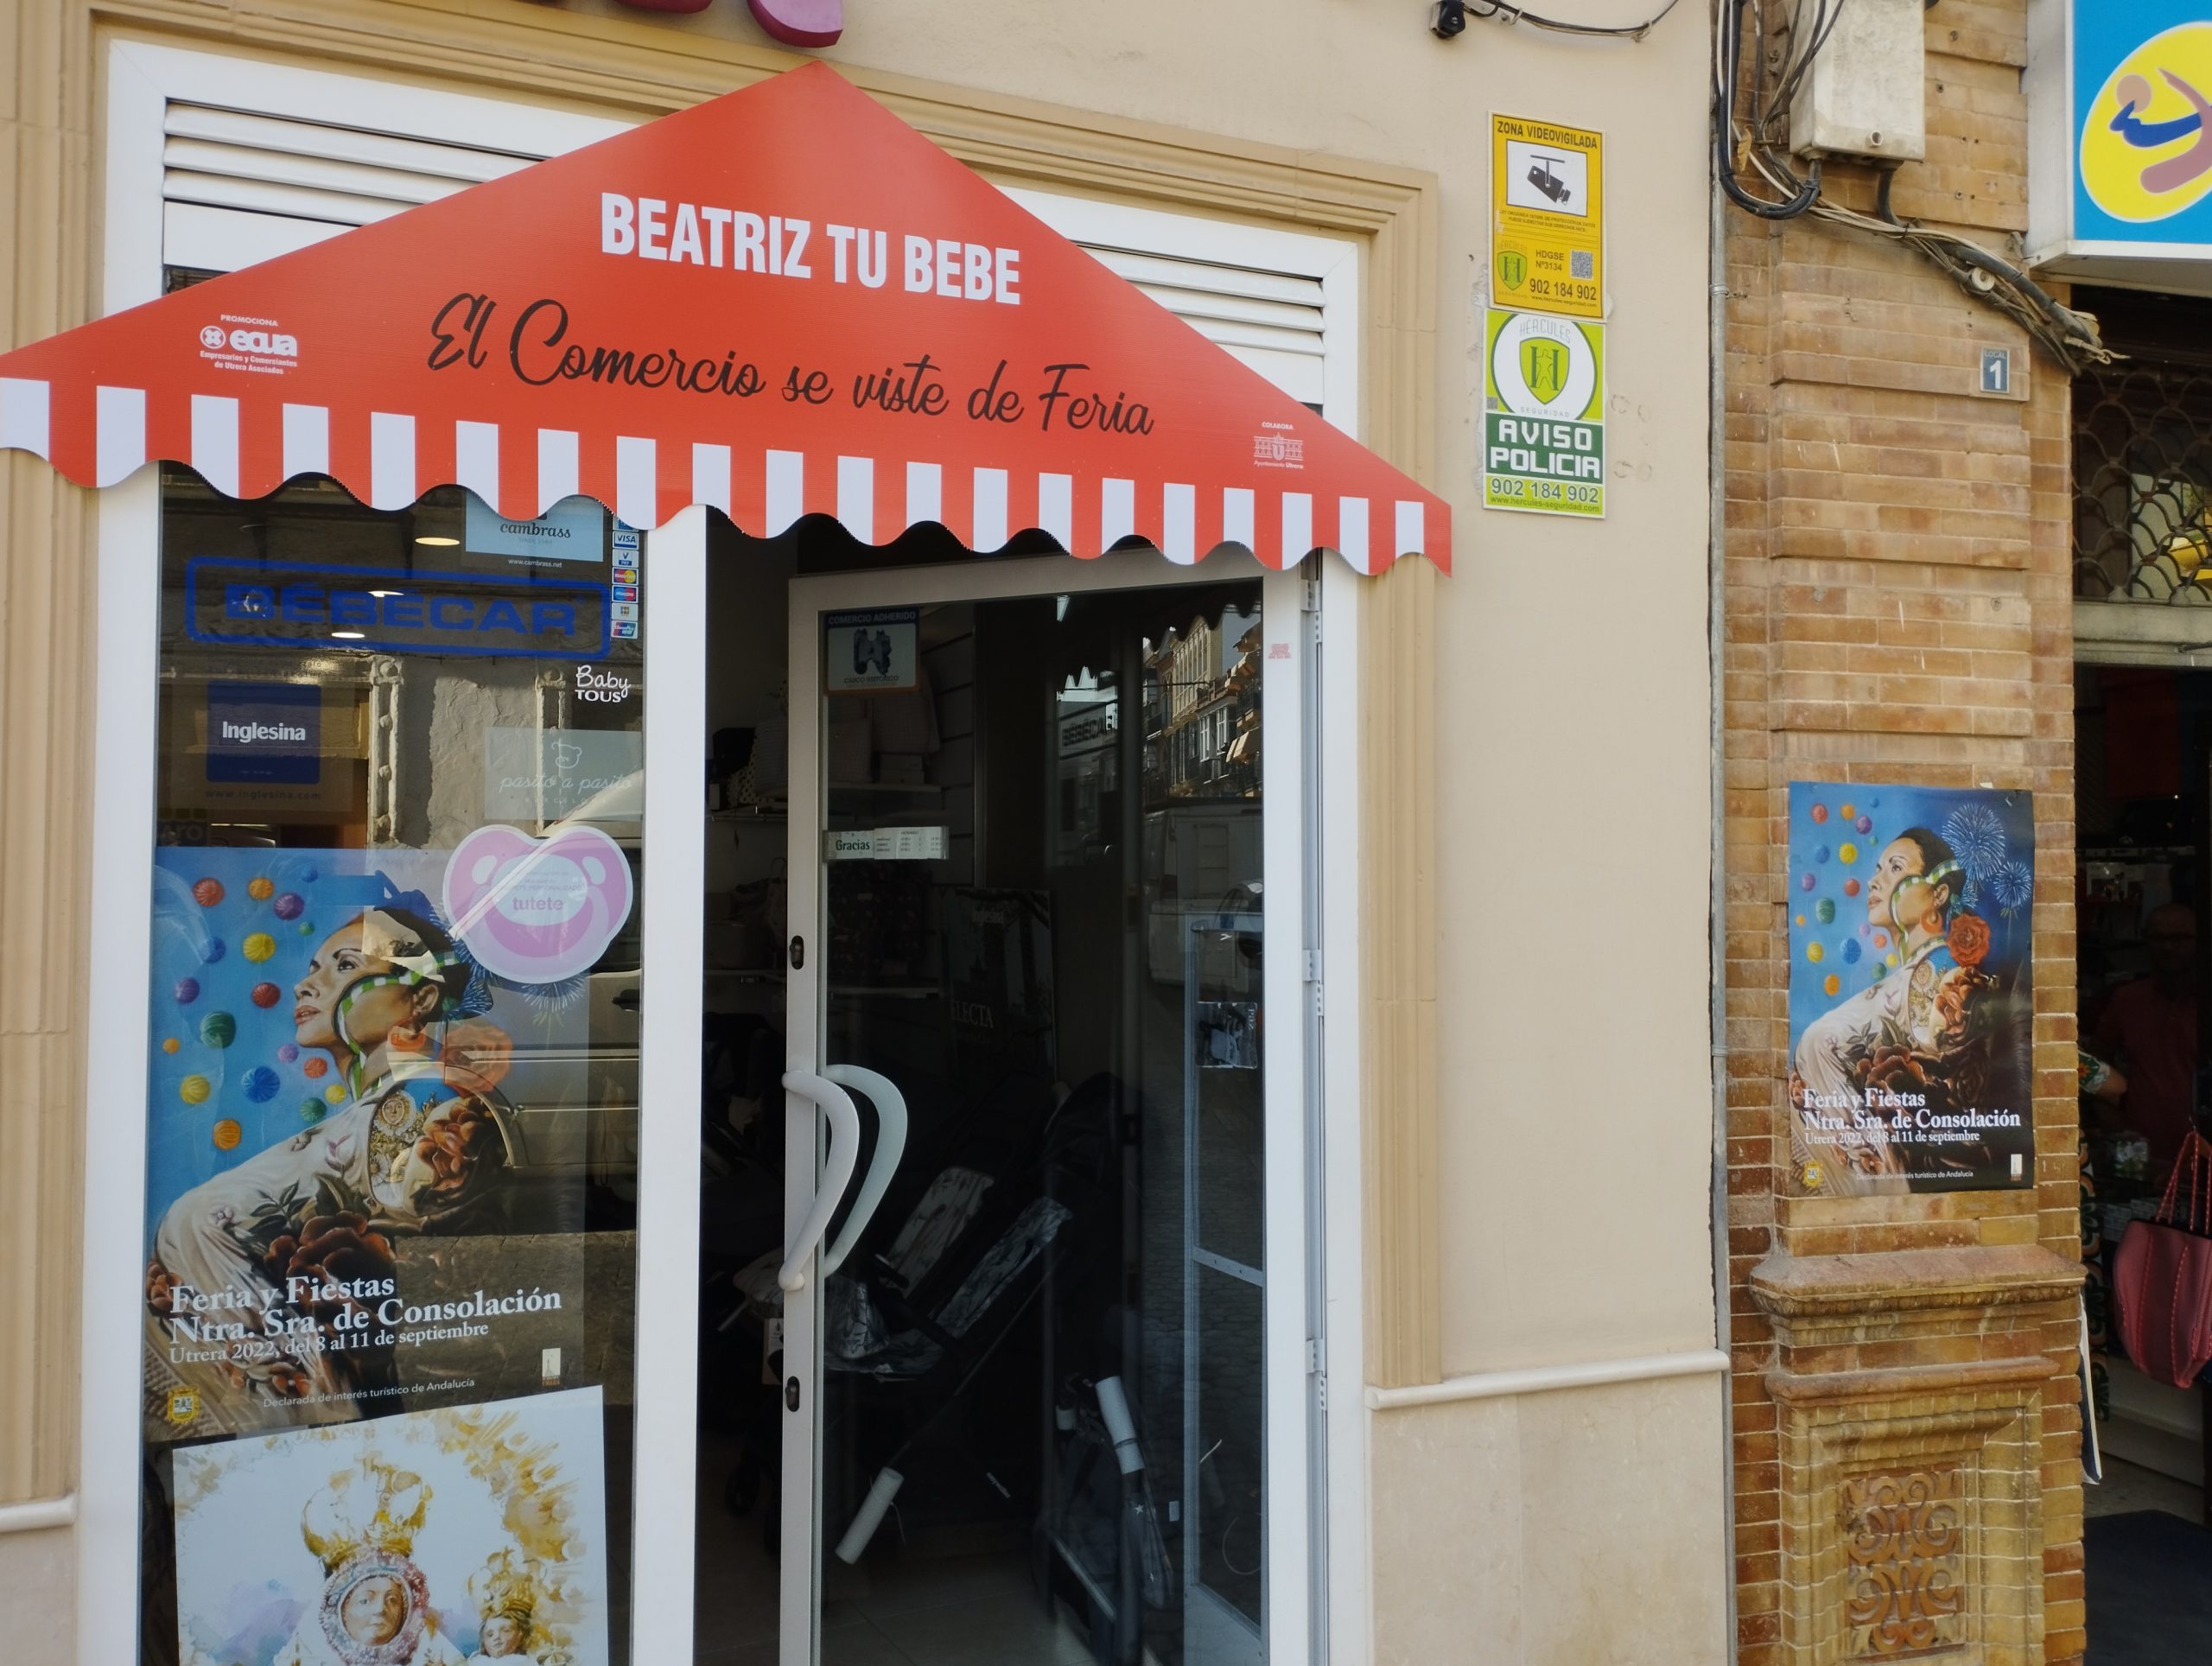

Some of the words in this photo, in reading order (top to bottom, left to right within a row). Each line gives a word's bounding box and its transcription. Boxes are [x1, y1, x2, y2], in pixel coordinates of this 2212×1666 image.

[1497, 120, 1523, 137] ZONA
[1527, 125, 1598, 149] VIDEOVIGILADA
[601, 192, 811, 279] BEATRIZ
[827, 225, 887, 289] TU
[904, 235, 1020, 305] BEBE
[1535, 250, 1565, 261] HDGSE
[1529, 278, 1549, 295] 902
[1554, 282, 1573, 298] 184
[1577, 285, 1597, 301] 902
[220, 315, 279, 327] PROMOCIONA
[200, 351, 244, 362] Empresarios
[250, 355, 297, 367] Comerciantes
[225, 362, 247, 371] Utrera
[248, 365, 284, 374] Asociados
[428, 293, 497, 371] El
[509, 298, 767, 397] Comercio
[781, 366, 834, 404] se
[853, 354, 950, 415] viste
[967, 359, 1024, 423] de
[1039, 363, 1154, 436] Feria
[1990, 359, 2001, 389] 1
[1520, 406, 1570, 417] SEGURIDAD
[1498, 419, 1592, 451] AVISO
[1491, 447, 1600, 479] POLICIA
[1491, 479, 1523, 496] 902
[1530, 482, 1562, 499] 184
[1567, 486, 1599, 503] 902
[1491, 496, 1600, 512] www.hercules-seguridad.com
[499, 522, 571, 538] cambrass
[618, 534, 637, 544] VISA
[508, 558, 563, 569] www.cambrass.net
[226, 582, 575, 637] BÉBÉCAR
[828, 614, 872, 625] COMERCIO
[873, 611, 916, 622] ADHERIDO
[575, 664, 632, 698] Baby
[575, 690, 622, 703] TOUS
[222, 721, 306, 743] Inglesina
[499, 773, 558, 794] pasito
[563, 777, 575, 789] a
[577, 773, 633, 794] pasito
[205, 790, 321, 801] www.inglesina.com
[836, 839, 870, 851] Gracias
[512, 896, 564, 912] tutete
[1803, 1089, 1847, 1108] Feria
[1851, 1095, 1862, 1113] y
[1865, 1088, 1926, 1107] Fiestas
[1803, 1110, 1850, 1130] Ntra.
[1854, 1110, 1888, 1129] Sra.
[1891, 1110, 1912, 1129] de
[1915, 1107, 2021, 1129] Consolación
[1805, 1133, 1836, 1144] Utrera
[1839, 1132, 1865, 1145] 2022,
[1866, 1131, 1882, 1143] del
[1883, 1131, 1890, 1142] 8
[1891, 1131, 1900, 1142] al
[1902, 1131, 1913, 1142] 11
[1915, 1130, 1927, 1142] de
[1928, 1129, 1980, 1145] septiembre
[169, 1284, 253, 1313] Feria
[259, 1288, 279, 1314] y
[285, 1276, 395, 1304] Fiestas
[168, 1316, 255, 1345] Ntra.
[264, 1308, 325, 1338] Sra.
[333, 1303, 370, 1332] de
[377, 1287, 563, 1326] Consolación
[169, 1347, 228, 1364] Utrera
[232, 1341, 280, 1360] 2022,
[284, 1337, 311, 1355] del
[316, 1336, 326, 1351] 8
[329, 1335, 346, 1351] al
[349, 1332, 372, 1348] 11
[374, 1329, 395, 1346] de
[398, 1320, 489, 1347] septiembre
[263, 1395, 316, 1408] Declarada
[317, 1392, 332, 1403] de
[334, 1389, 368, 1402] interés
[370, 1384, 410, 1397] turístico
[411, 1383, 425, 1393] de
[426, 1377, 475, 1391] Andalucía
